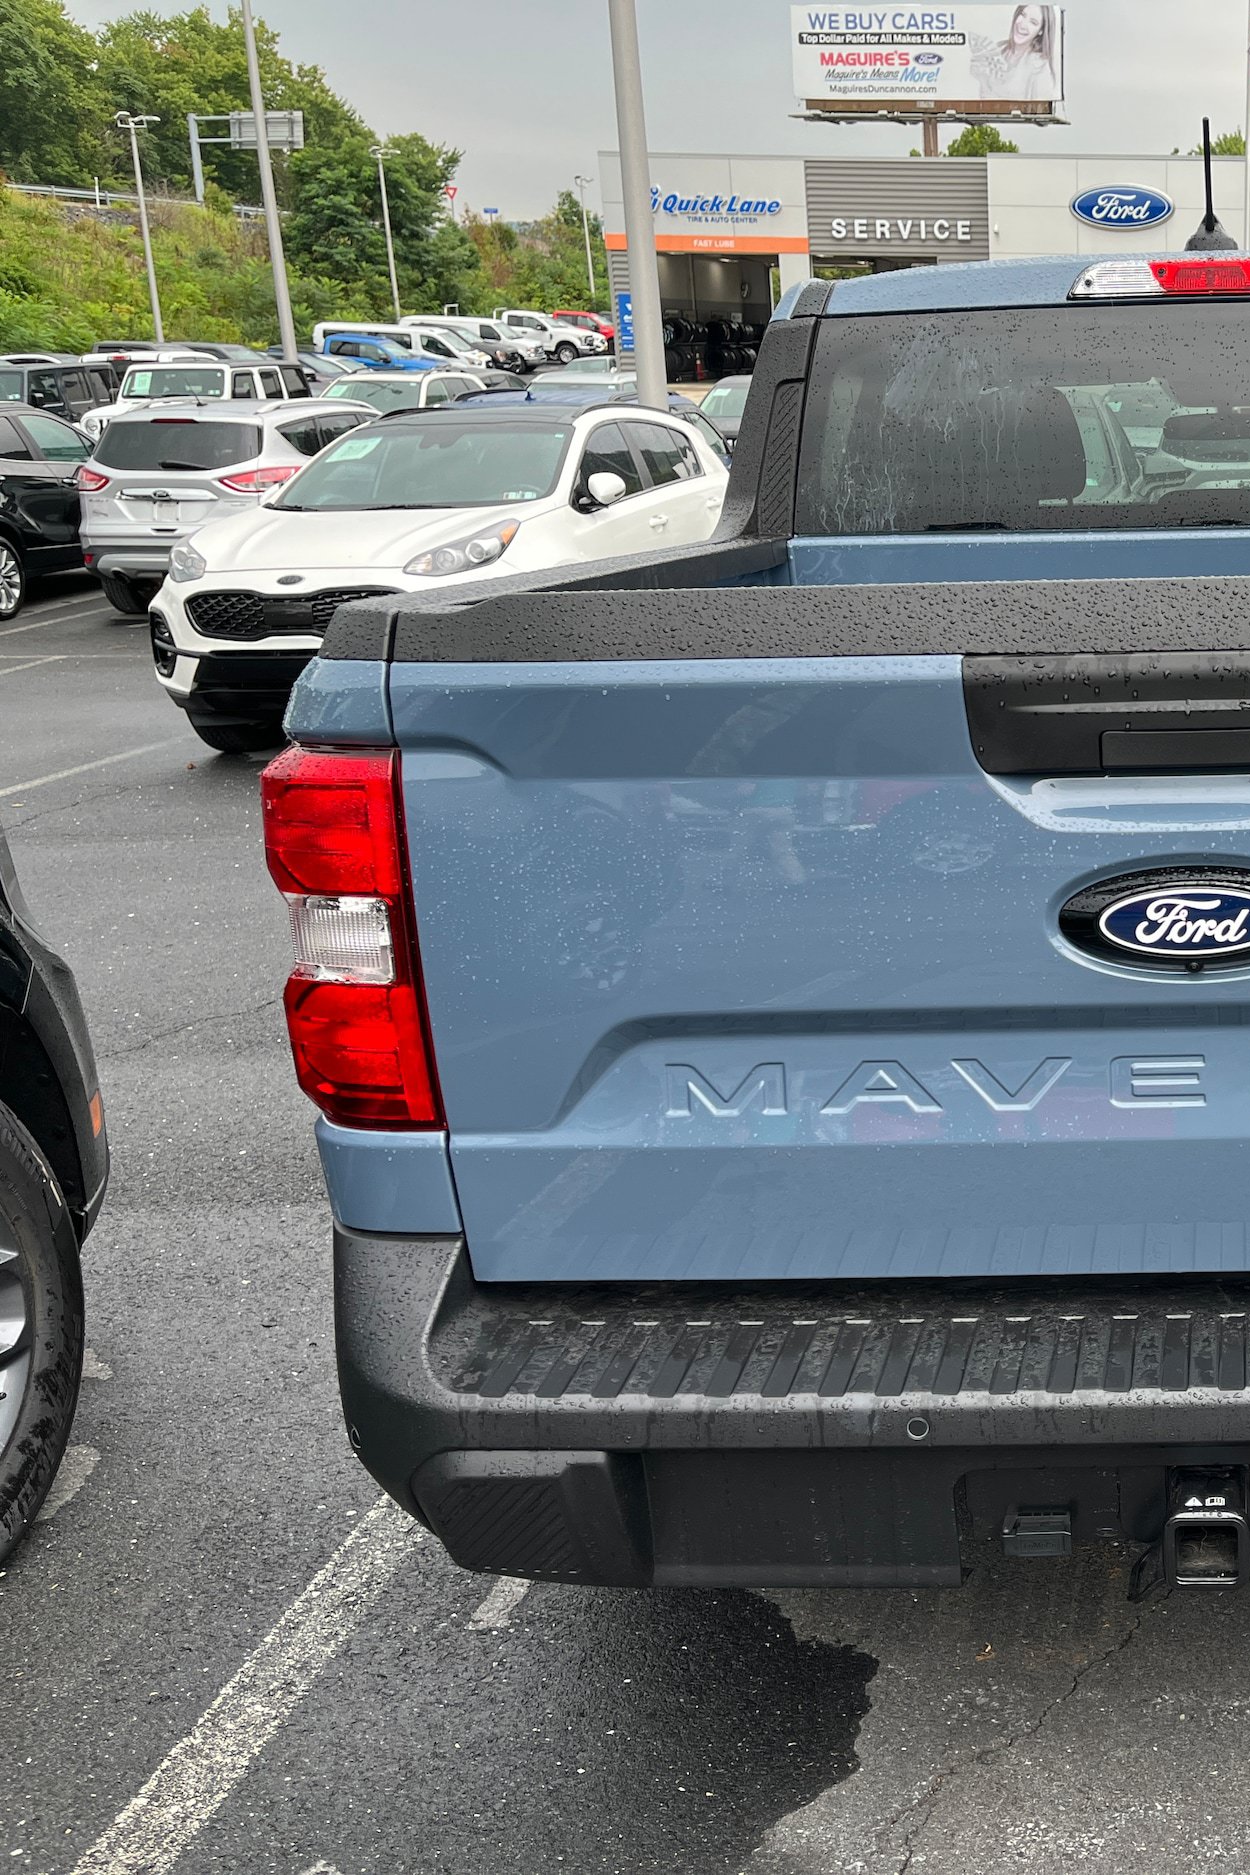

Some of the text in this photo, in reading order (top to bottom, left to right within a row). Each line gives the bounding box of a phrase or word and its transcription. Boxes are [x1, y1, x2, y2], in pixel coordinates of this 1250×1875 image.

[808, 12, 955, 30] WE BUY CARS!
[801, 33, 963, 44] Top Dollar Paid for All Makes & Models
[820, 50, 910, 66] MAGUIRE'S
[825, 67, 940, 82] Maguire's Means More!
[829, 84, 937, 94] MaguiresDuncannon.com
[662, 194, 780, 213] Quick Lane
[1091, 193, 1151, 220] Ford
[687, 215, 703, 223] TIRE
[730, 216, 758, 224] CENTER
[831, 217, 972, 242] SERVICE
[693, 239, 712, 248] FAST
[1134, 898, 1250, 944] Ford
